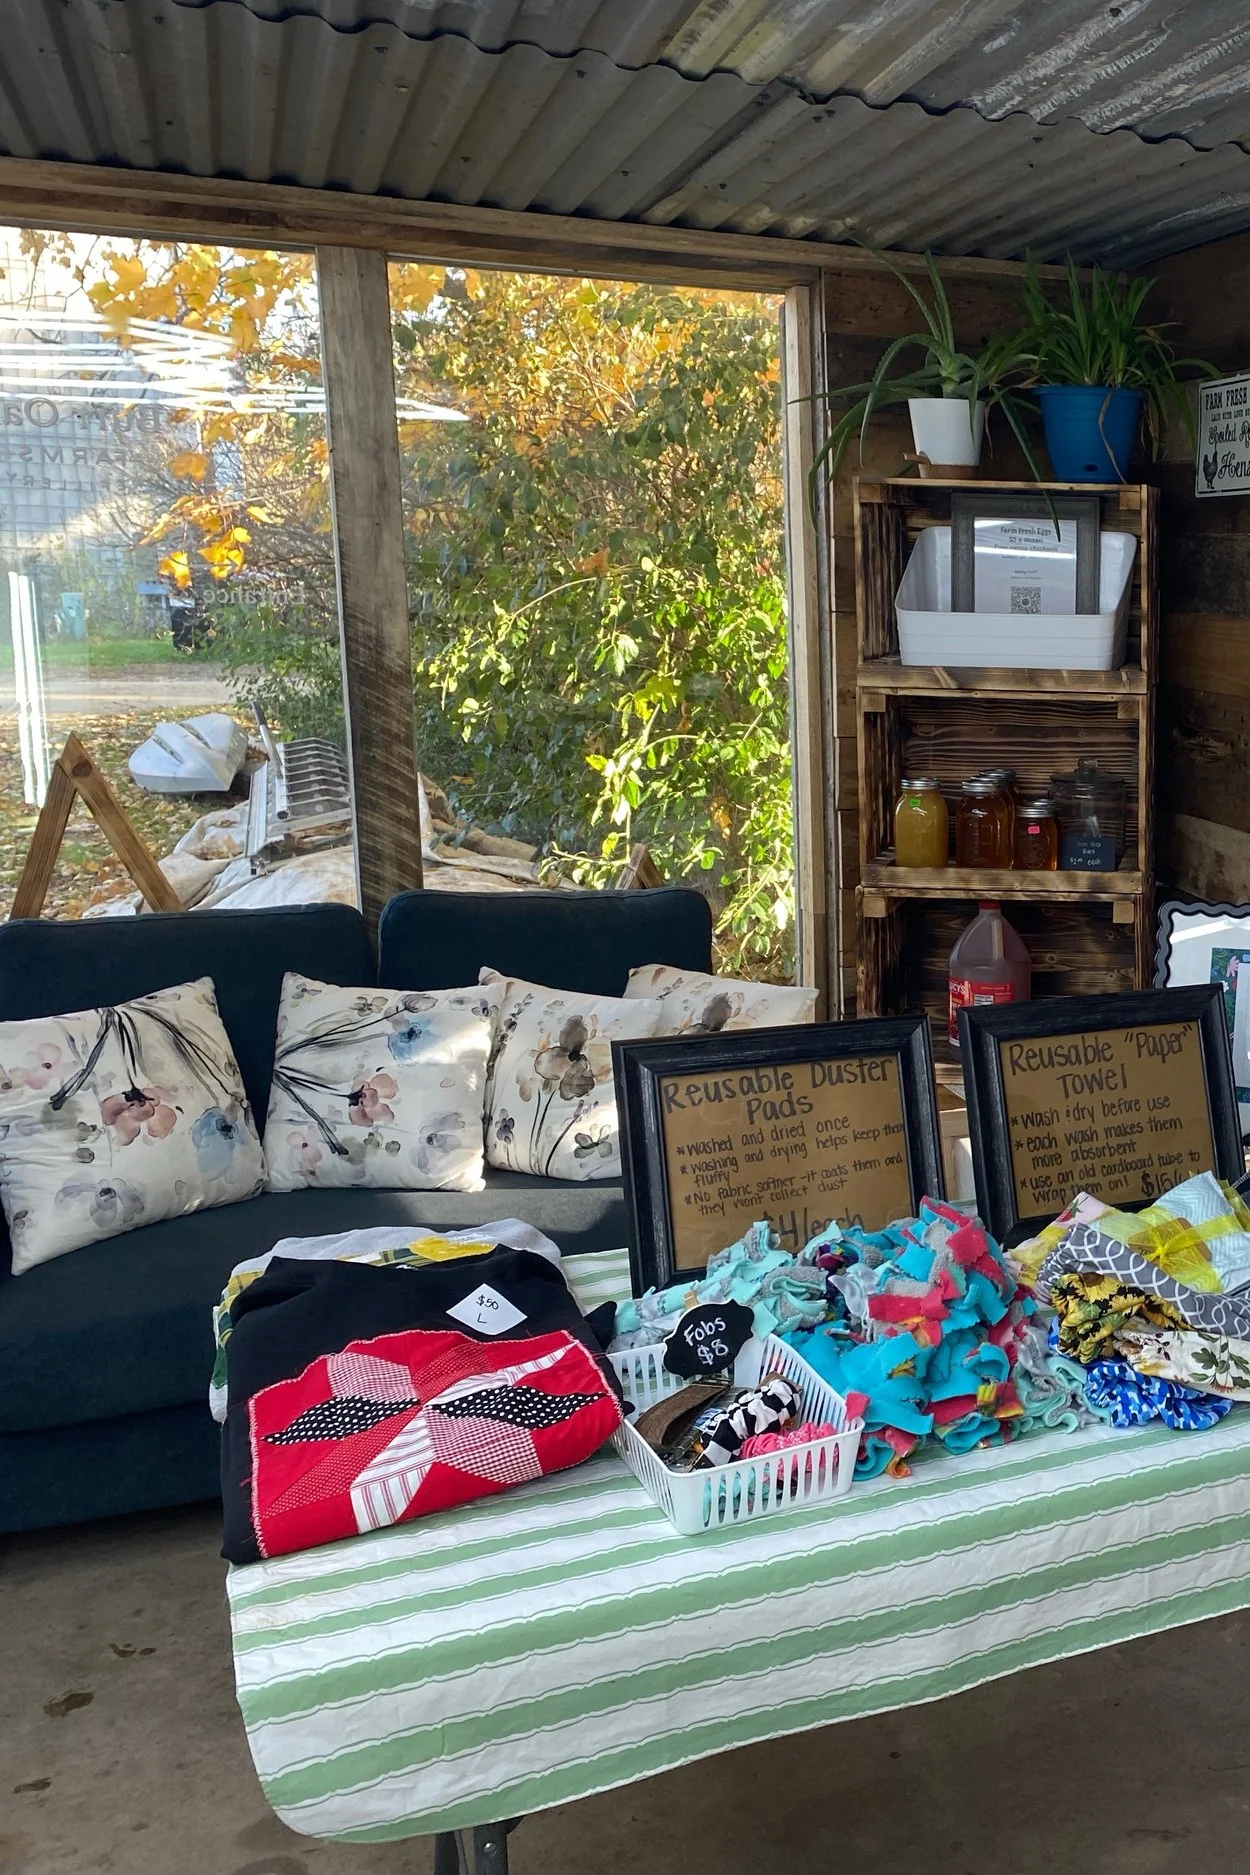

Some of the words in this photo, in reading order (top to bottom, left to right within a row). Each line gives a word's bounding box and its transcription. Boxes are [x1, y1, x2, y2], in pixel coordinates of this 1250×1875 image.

[1205, 391, 1223, 411] FARM
[1226, 386, 1248, 407] FRESH
[1211, 412, 1221, 422] LAID
[1222, 411, 1232, 420] WITH
[1234, 409, 1244, 419] LOVE
[1244, 408, 1250, 416] BY
[1208, 423, 1237, 451] Spoiled
[1000, 526, 1018, 534] Farm
[1018, 527, 1036, 535] Fresh
[1036, 528, 1052, 536] Eggs
[1008, 1035, 1114, 1076] Reusable
[662, 1066, 794, 1114] Reusable
[810, 1056, 893, 1089] Duster
[745, 1091, 814, 1125] Pads
[1021, 1108, 1060, 1129] wash
[1072, 1102, 1095, 1123] dry
[1102, 1096, 1142, 1118] before
[1146, 1094, 1171, 1111] use
[741, 1130, 765, 1146] and
[770, 1121, 807, 1141] dried
[816, 1115, 851, 1133] once
[1063, 1126, 1099, 1145] wash
[1104, 1120, 1144, 1140] makes
[1147, 1116, 1183, 1133] them
[744, 1149, 765, 1164] and
[769, 1141, 808, 1162] drying
[815, 1134, 848, 1152] helps
[853, 1128, 881, 1145] keep
[1032, 1152, 1063, 1170] more
[1070, 1138, 1137, 1162] absorbent
[693, 1190, 711, 1205] No
[717, 1181, 751, 1200] fabric
[756, 1174, 794, 1193] softner
[821, 1164, 849, 1180] coats
[852, 1158, 881, 1173] them
[884, 1152, 903, 1167] and
[694, 1170, 730, 1189] fluffy
[1057, 1170, 1075, 1183] an
[1078, 1163, 1097, 1180] old
[1101, 1155, 1154, 1177] cardboard
[1156, 1151, 1184, 1167] tube
[1188, 1148, 1201, 1162] to
[700, 1202, 725, 1217] they
[770, 1186, 808, 1203] collect
[818, 1178, 849, 1192] dust
[1032, 1187, 1067, 1206] wrap
[1071, 1180, 1102, 1196] them
[1108, 1177, 1130, 1192] on!
[476, 1294, 499, 1310] $50
[477, 1312, 487, 1324] L
[683, 1317, 726, 1347] Fobs
[697, 1338, 729, 1366] $8
